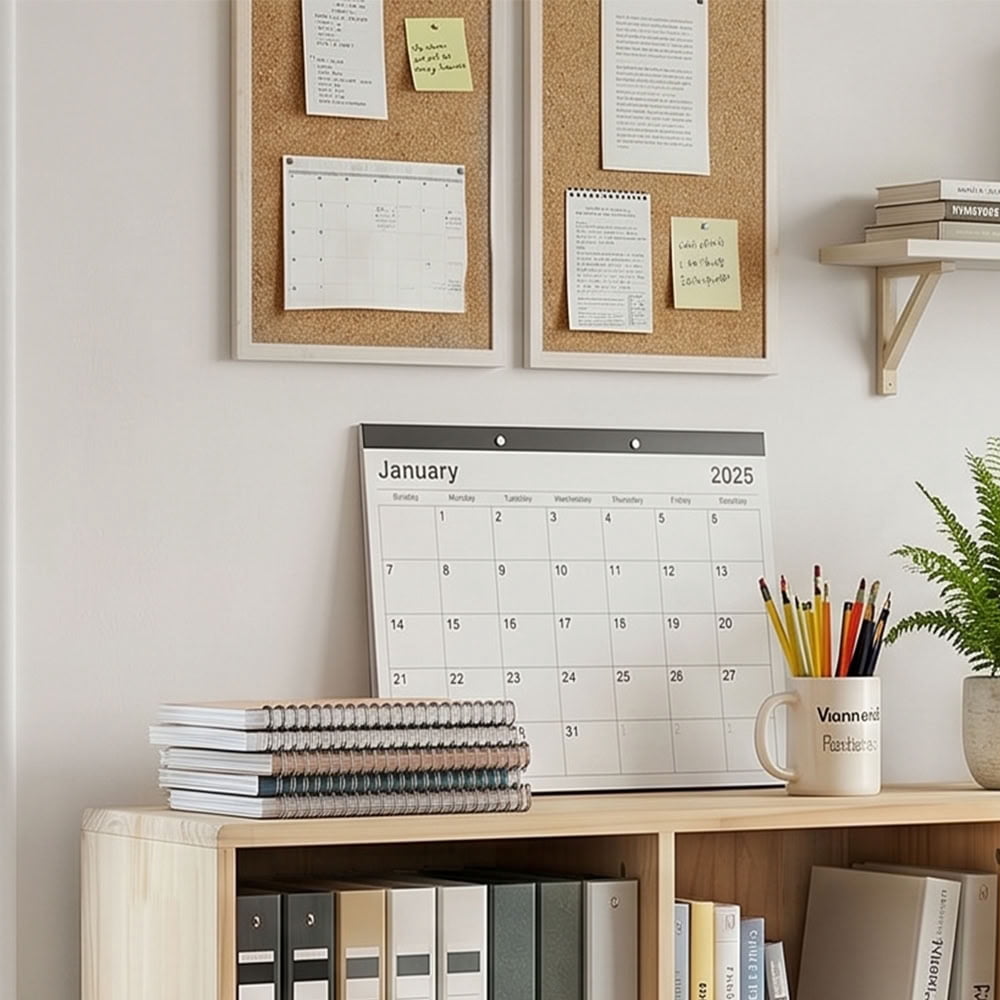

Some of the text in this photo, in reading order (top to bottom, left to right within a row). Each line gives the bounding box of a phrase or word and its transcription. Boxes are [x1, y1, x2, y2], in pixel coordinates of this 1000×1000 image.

[378, 460, 754, 485] January 2025
[439, 510, 445, 522] 1
[495, 511, 502, 523] 2
[550, 511, 557, 523] 3
[604, 512, 612, 523] 4
[658, 512, 666, 524] 5
[386, 564, 728, 577] 7 8 9 10 11 12 13
[391, 618, 404, 630] 14
[447, 618, 461, 630] 15
[504, 617, 517, 630] 16
[559, 617, 572, 629] 17
[667, 617, 680, 630] 19
[718, 616, 733, 629] 20
[393, 669, 736, 685] 21 22 23 24 25 26 27
[565, 725, 578, 737] 31
